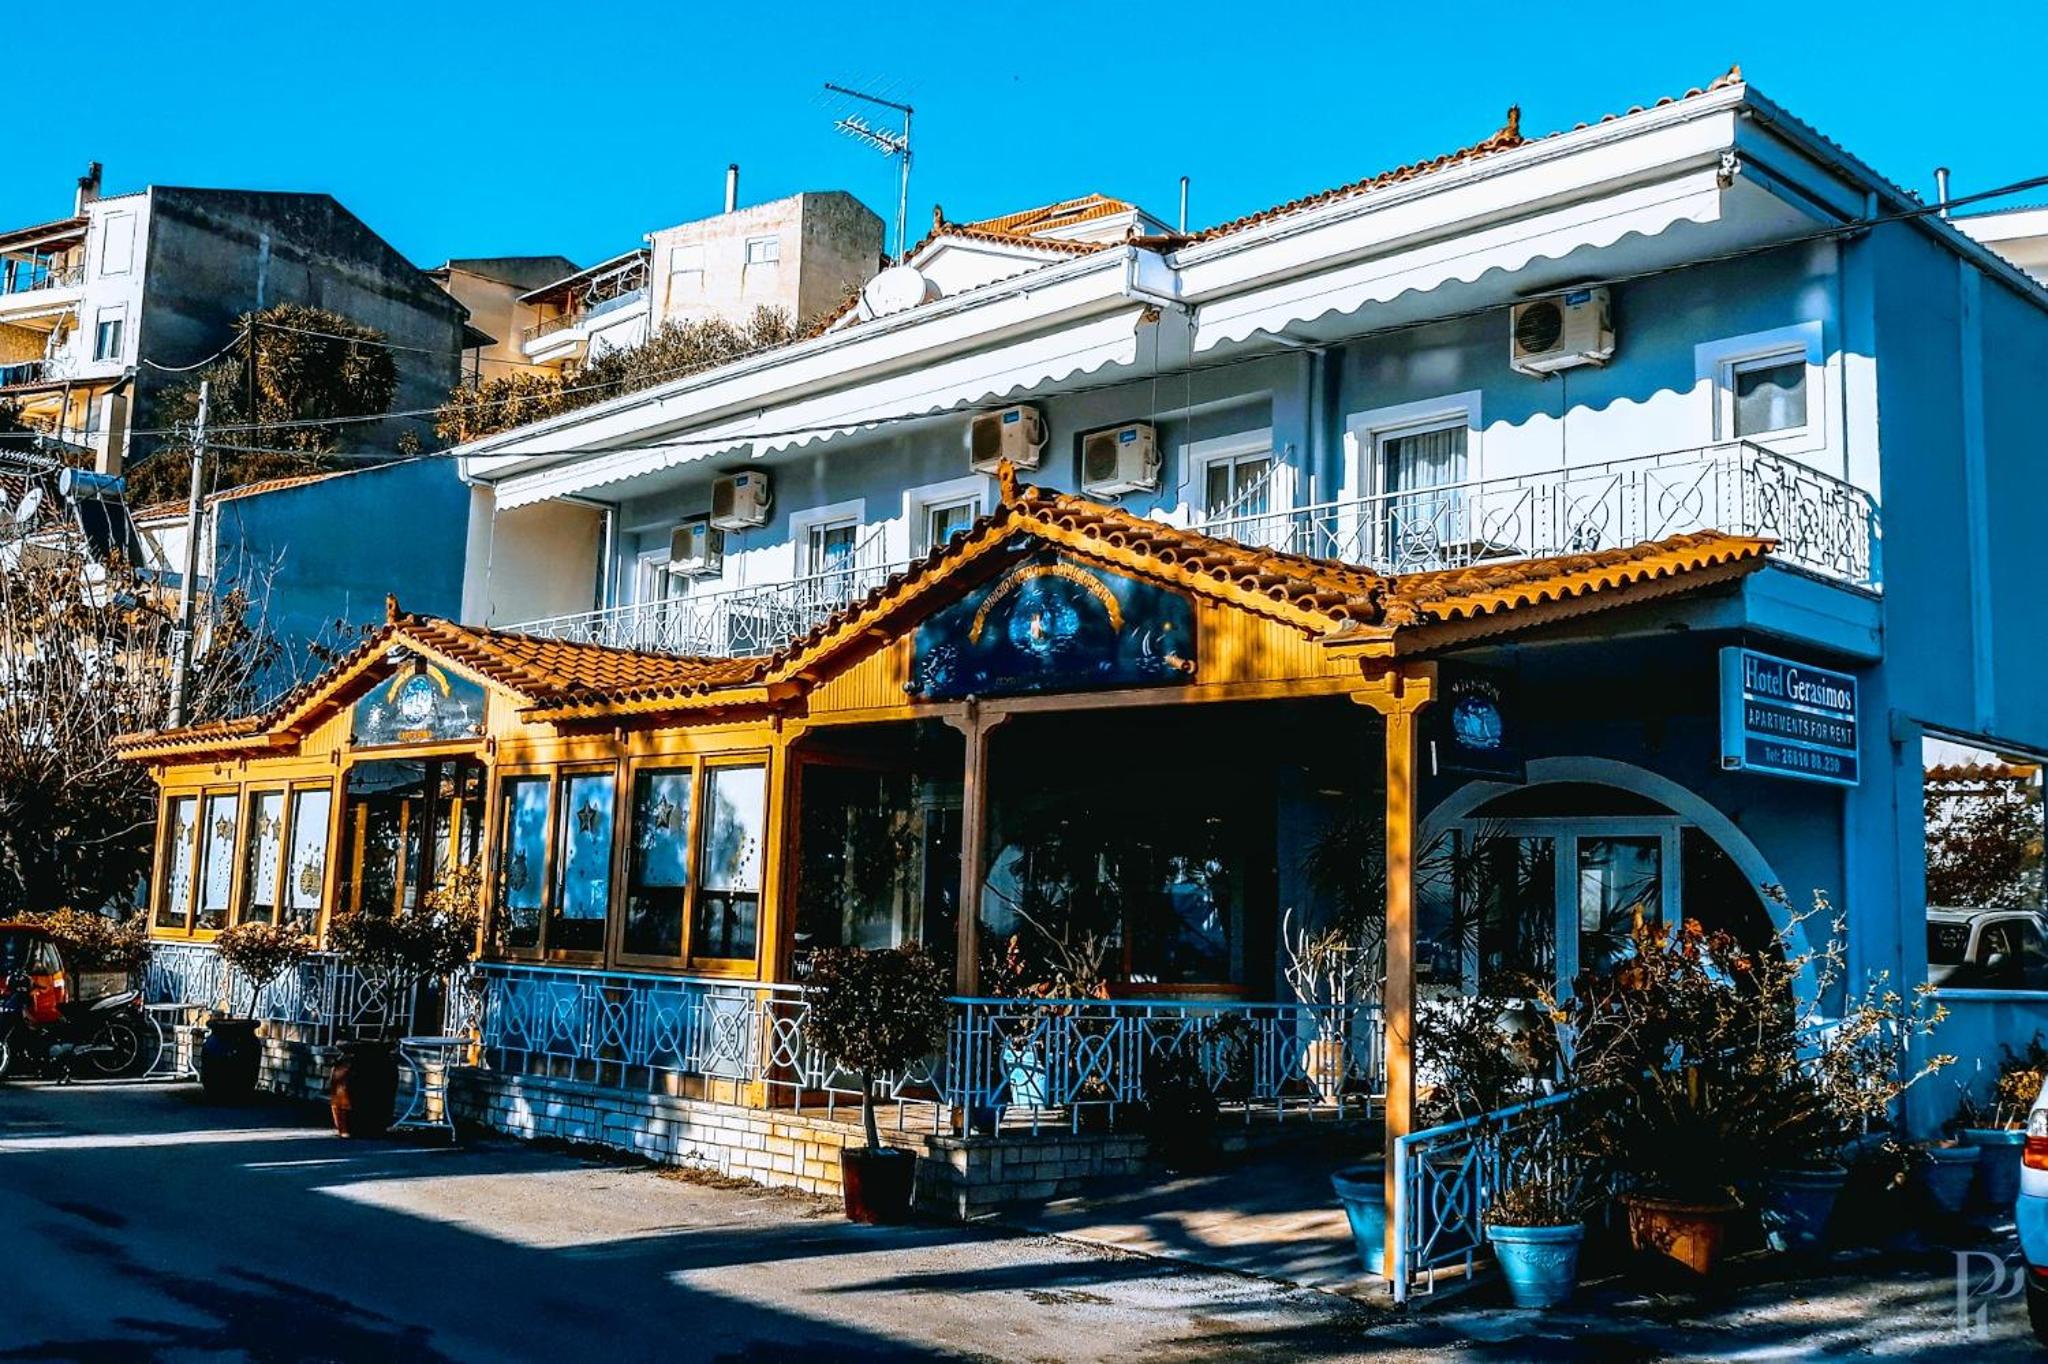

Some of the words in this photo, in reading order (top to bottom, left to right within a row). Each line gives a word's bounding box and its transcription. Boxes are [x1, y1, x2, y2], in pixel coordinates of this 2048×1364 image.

[1745, 656, 1783, 696] Hotel
[1786, 668, 1851, 710] Gerasimos
[1748, 708, 1809, 736] APARTMENTS
[1811, 722, 1828, 739] FOR
[1830, 727, 1852, 744] RENT
